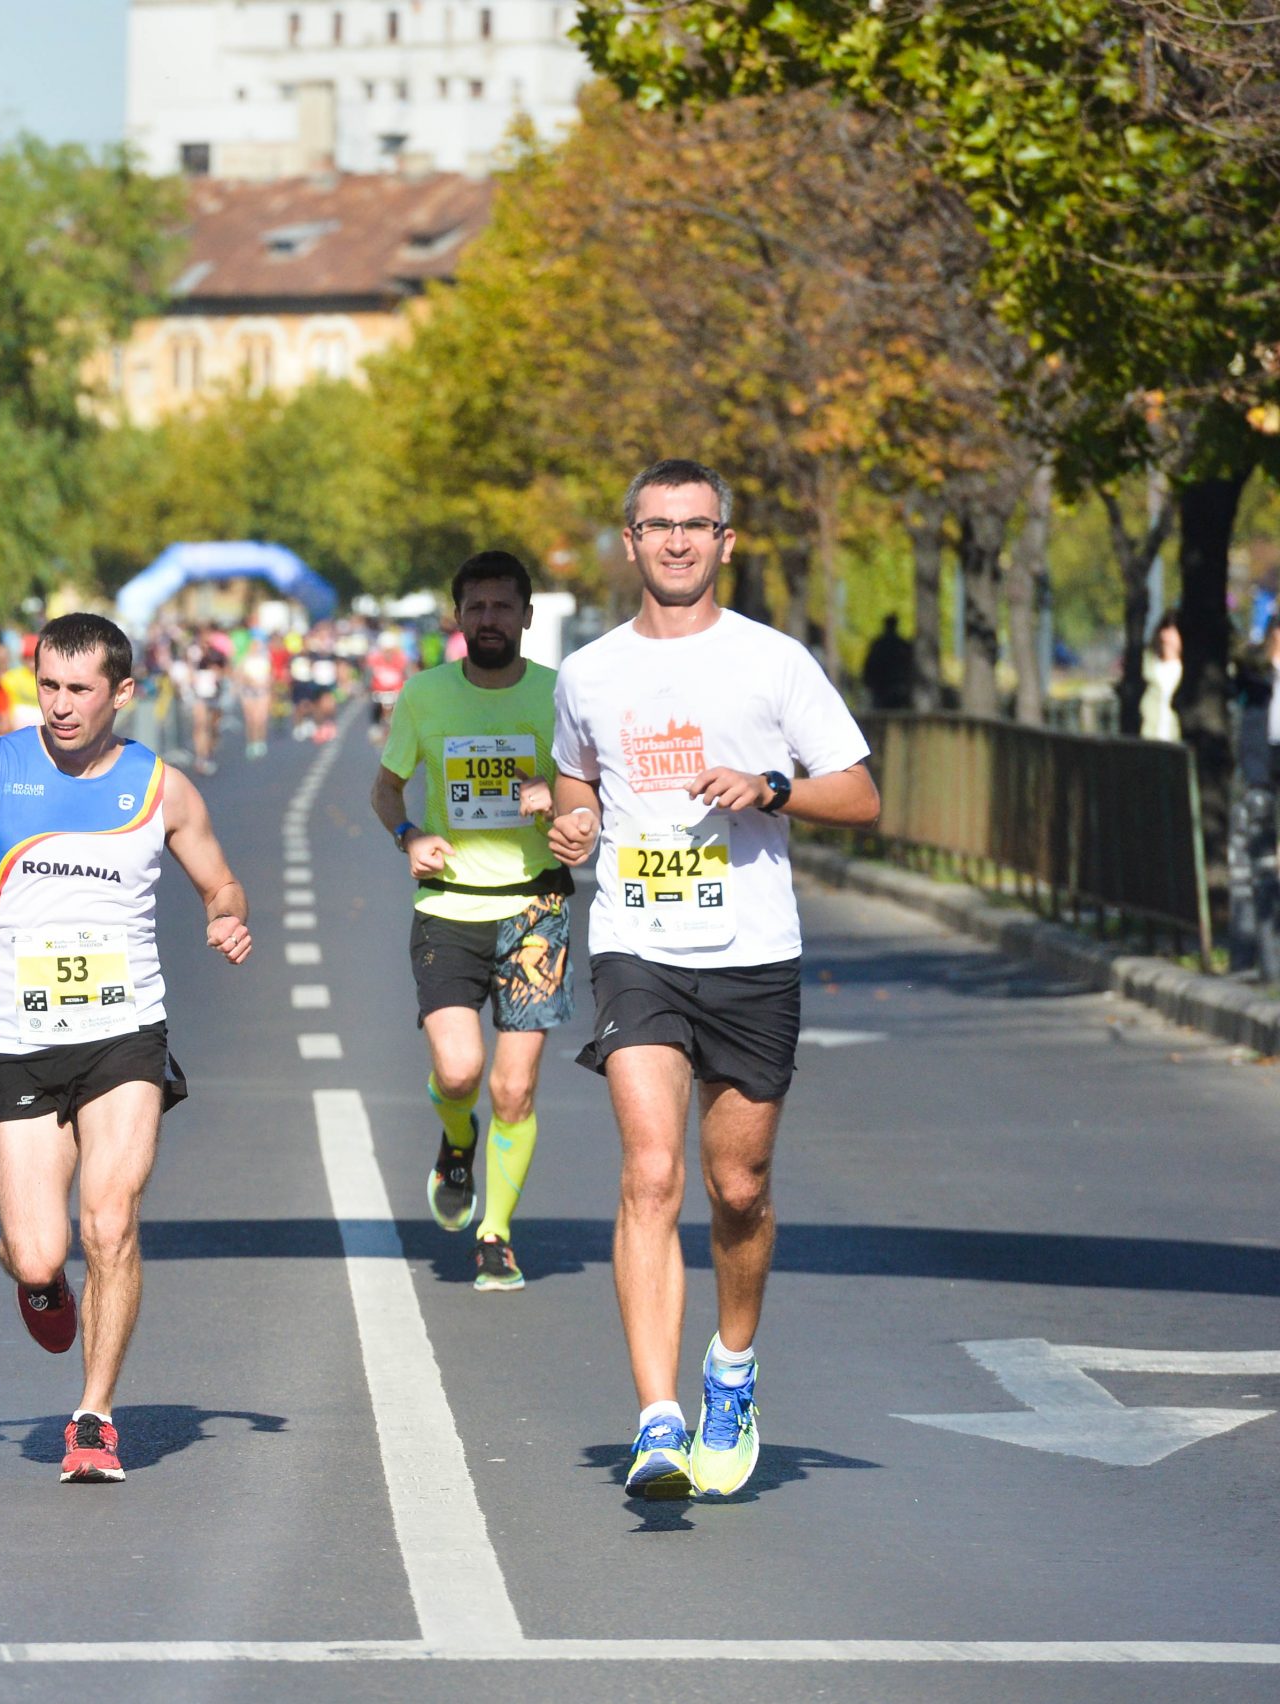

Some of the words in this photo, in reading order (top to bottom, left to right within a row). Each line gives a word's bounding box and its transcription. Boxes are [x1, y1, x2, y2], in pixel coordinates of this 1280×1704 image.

[634, 737, 702, 751] UrbanTrail
[465, 757, 516, 779] 1038
[638, 752, 706, 777] SINAIA
[24, 783, 45, 791] CLUB
[22, 861, 121, 883] ROMANIA
[638, 849, 702, 877] 2242
[57, 956, 89, 983] 53
